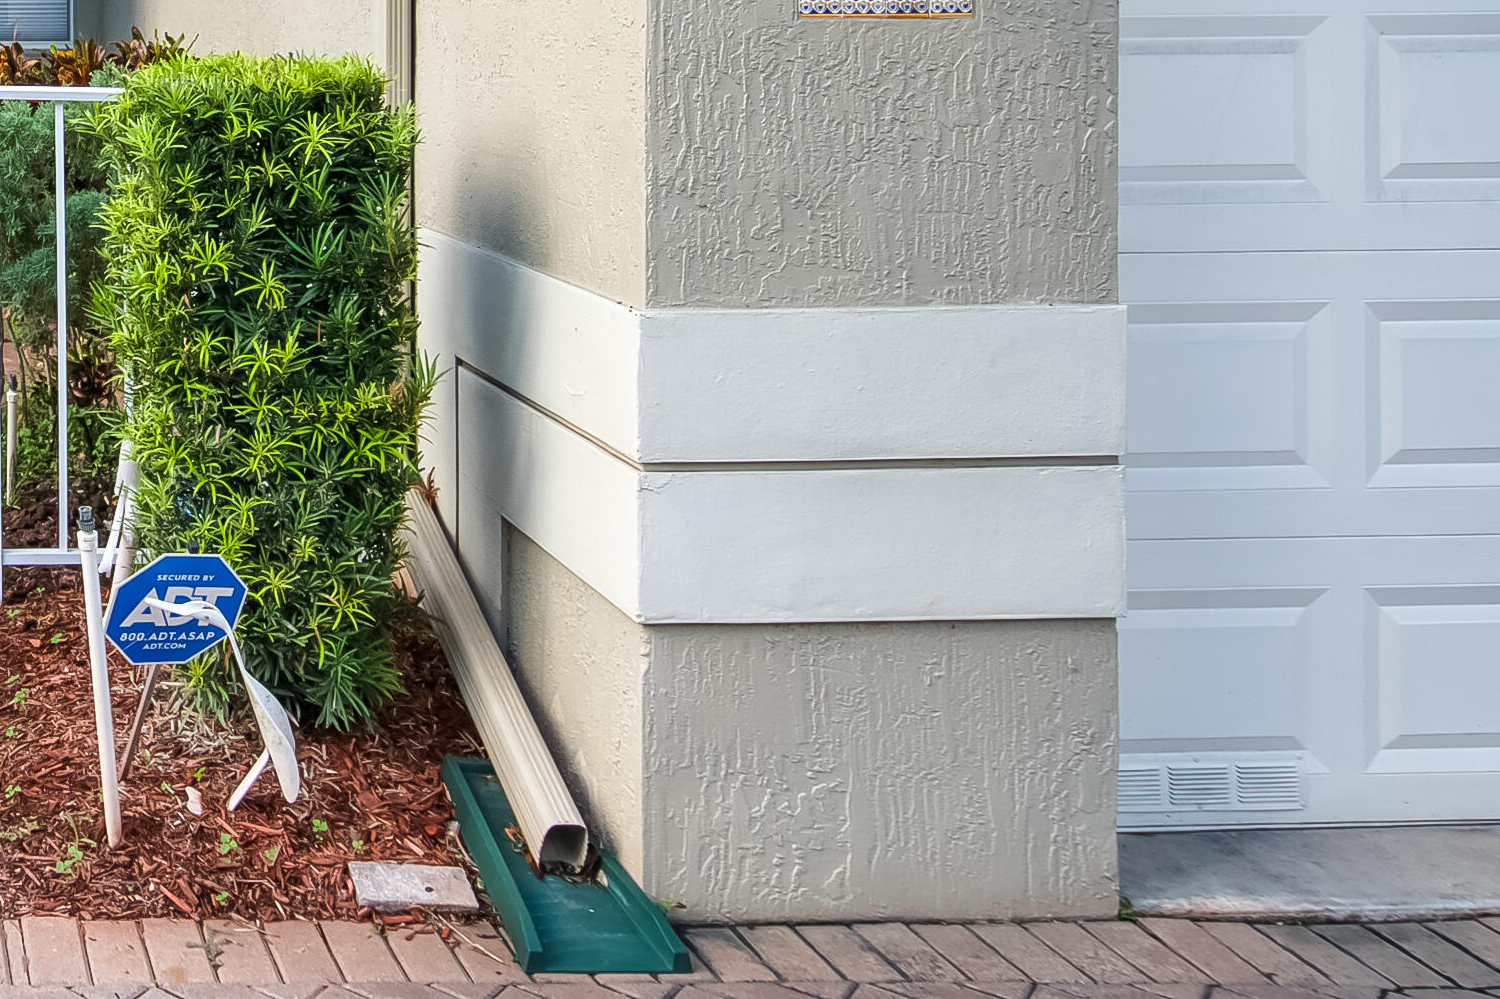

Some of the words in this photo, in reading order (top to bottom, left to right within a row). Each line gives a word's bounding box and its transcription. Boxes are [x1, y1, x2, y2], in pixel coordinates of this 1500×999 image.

[156, 574, 200, 582] SECURED
[202, 574, 215, 582] BY
[119, 586, 235, 628] ADT
[119, 631, 216, 642] 800.ADT.ASAP
[142, 642, 187, 650] ADT.COM
